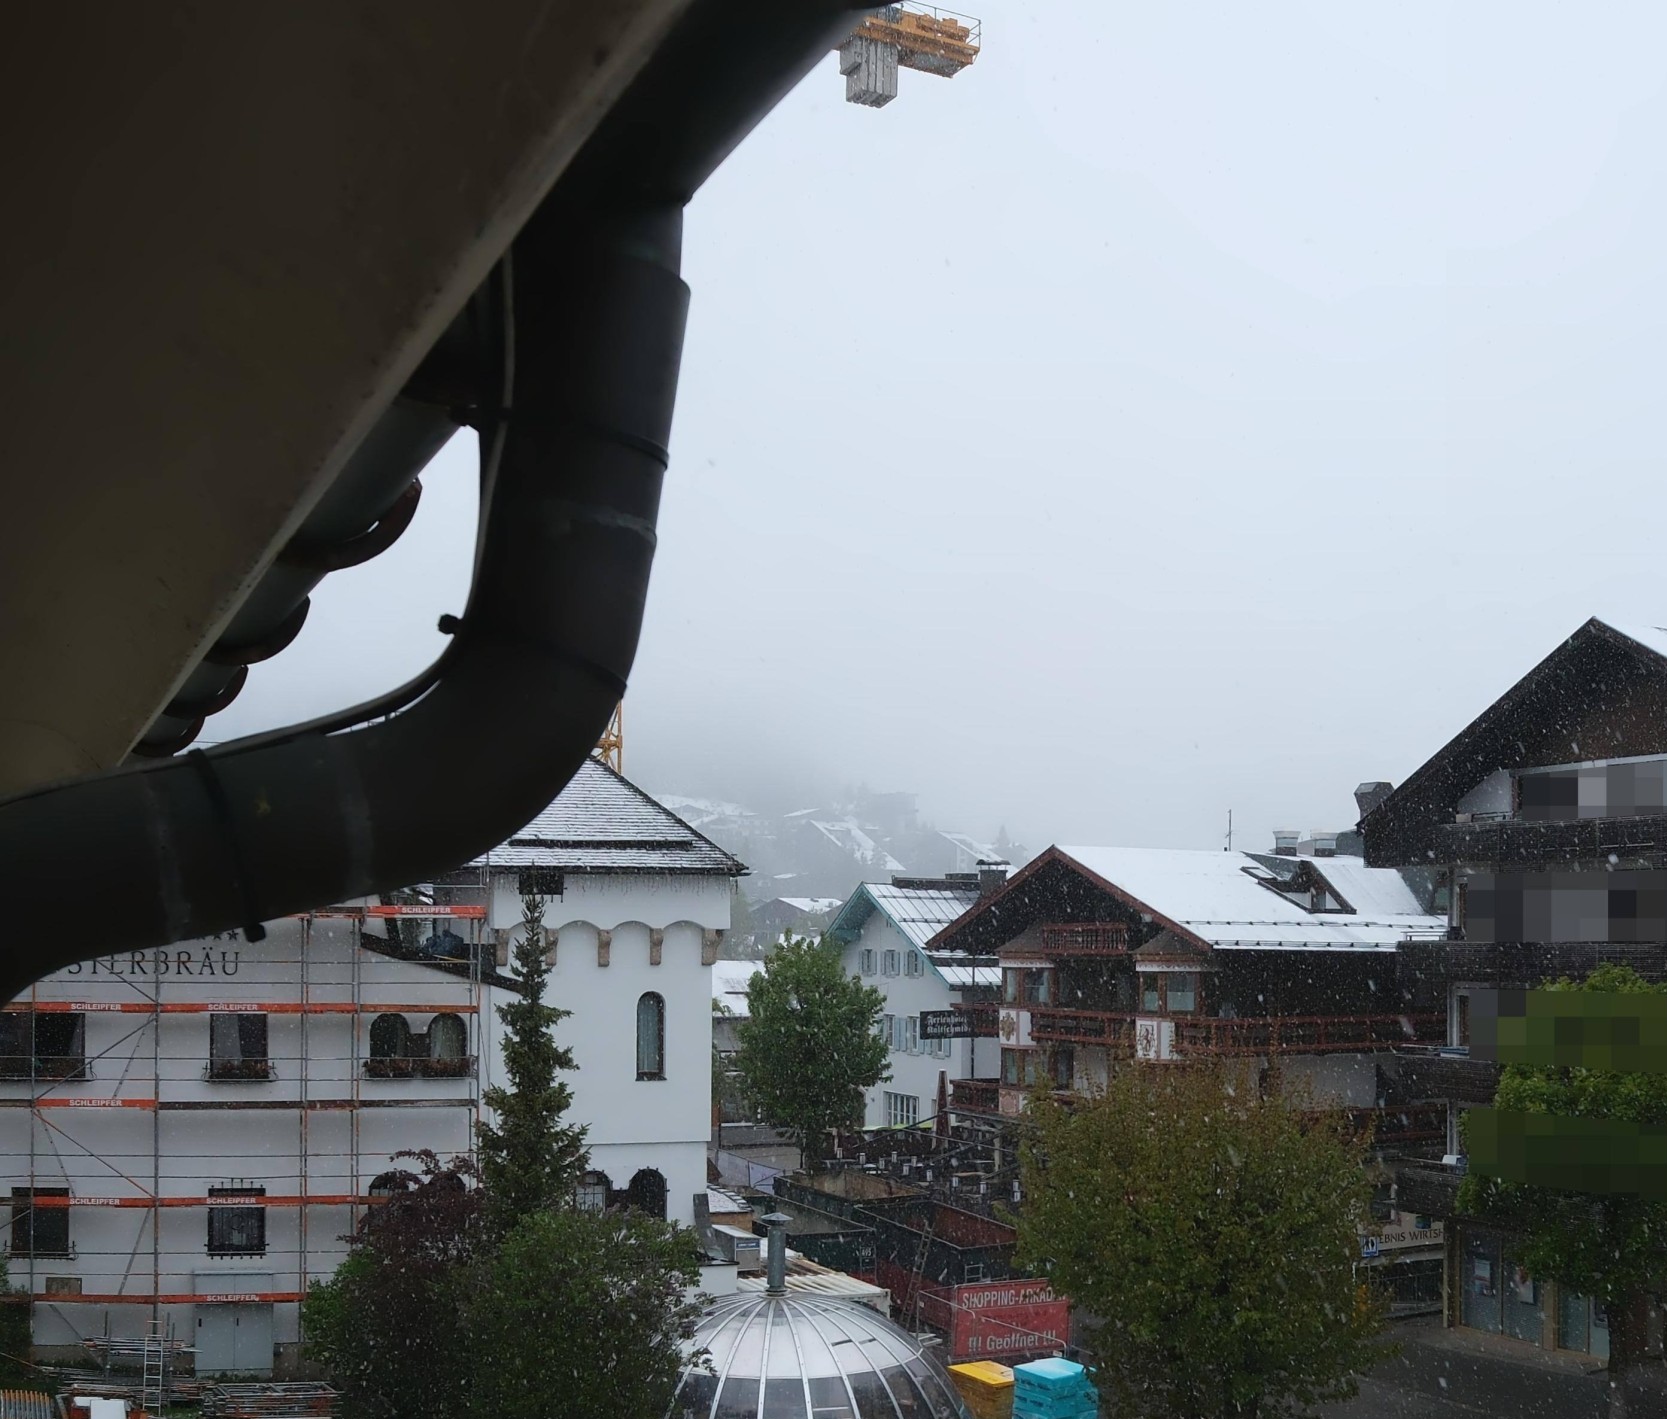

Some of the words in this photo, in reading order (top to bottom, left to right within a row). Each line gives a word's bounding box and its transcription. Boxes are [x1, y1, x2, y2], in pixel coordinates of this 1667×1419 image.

[52, 948, 240, 976] STERBRÄU
[70, 1003, 121, 1011] SCHLEIPFER
[207, 1003, 258, 1011] SCHLEIPFER
[69, 1099, 122, 1107] SCHLEIPFER
[987, 1334, 1039, 1350] Geöffnet
